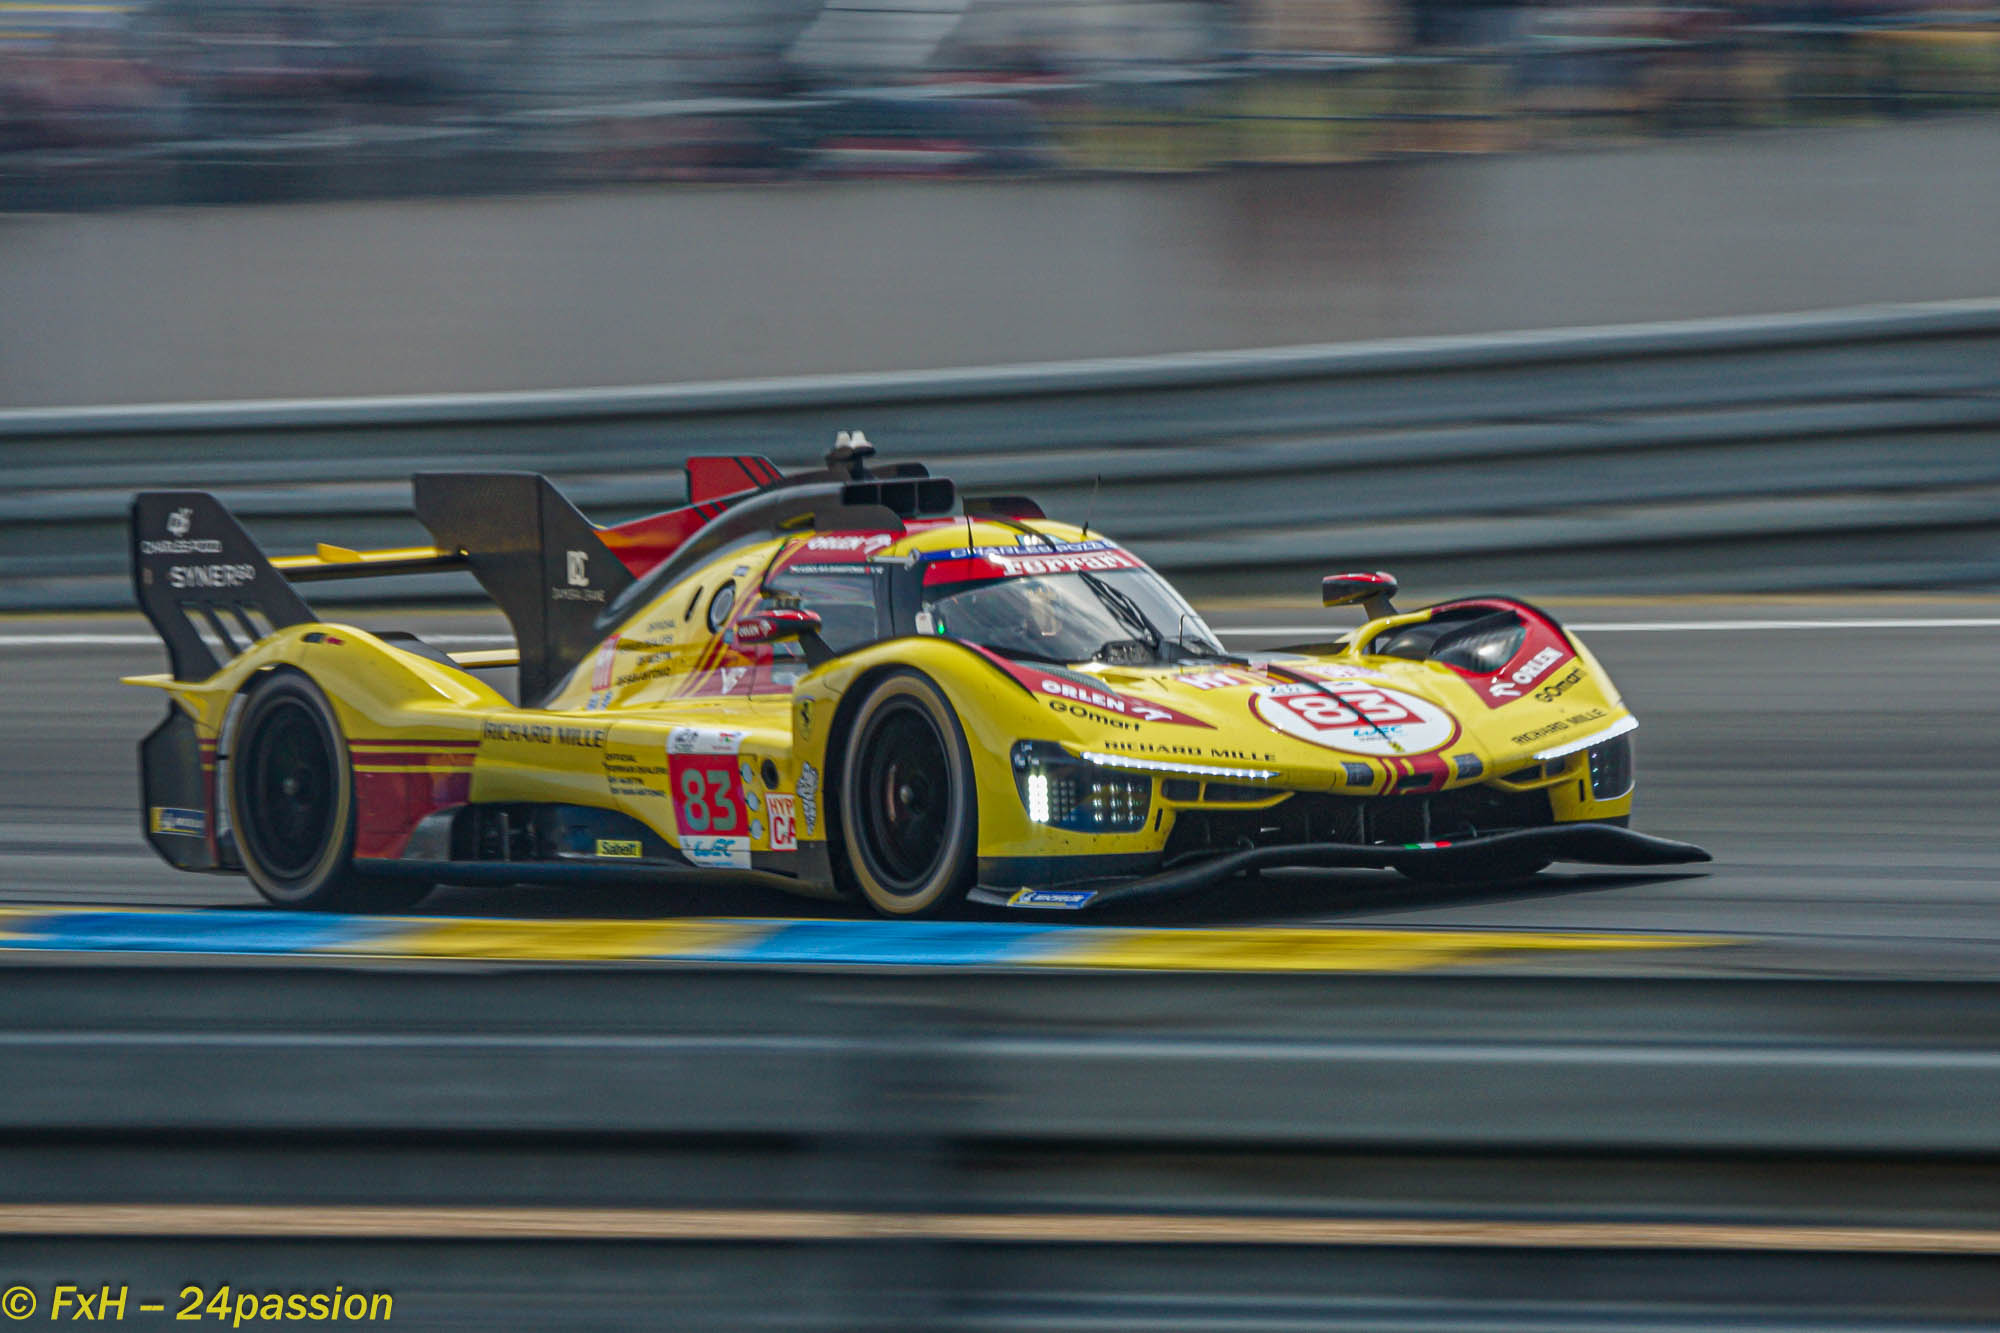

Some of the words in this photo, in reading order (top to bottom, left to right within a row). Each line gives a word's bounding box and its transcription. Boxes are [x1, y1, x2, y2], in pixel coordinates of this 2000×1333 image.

[1041, 680, 1125, 712] ORLEN
[1287, 690, 1410, 726] 83
[1049, 700, 1140, 732] GOmart
[1104, 740, 1202, 757] RICHARD
[1210, 748, 1277, 762] MILLE
[681, 768, 737, 832] 83
